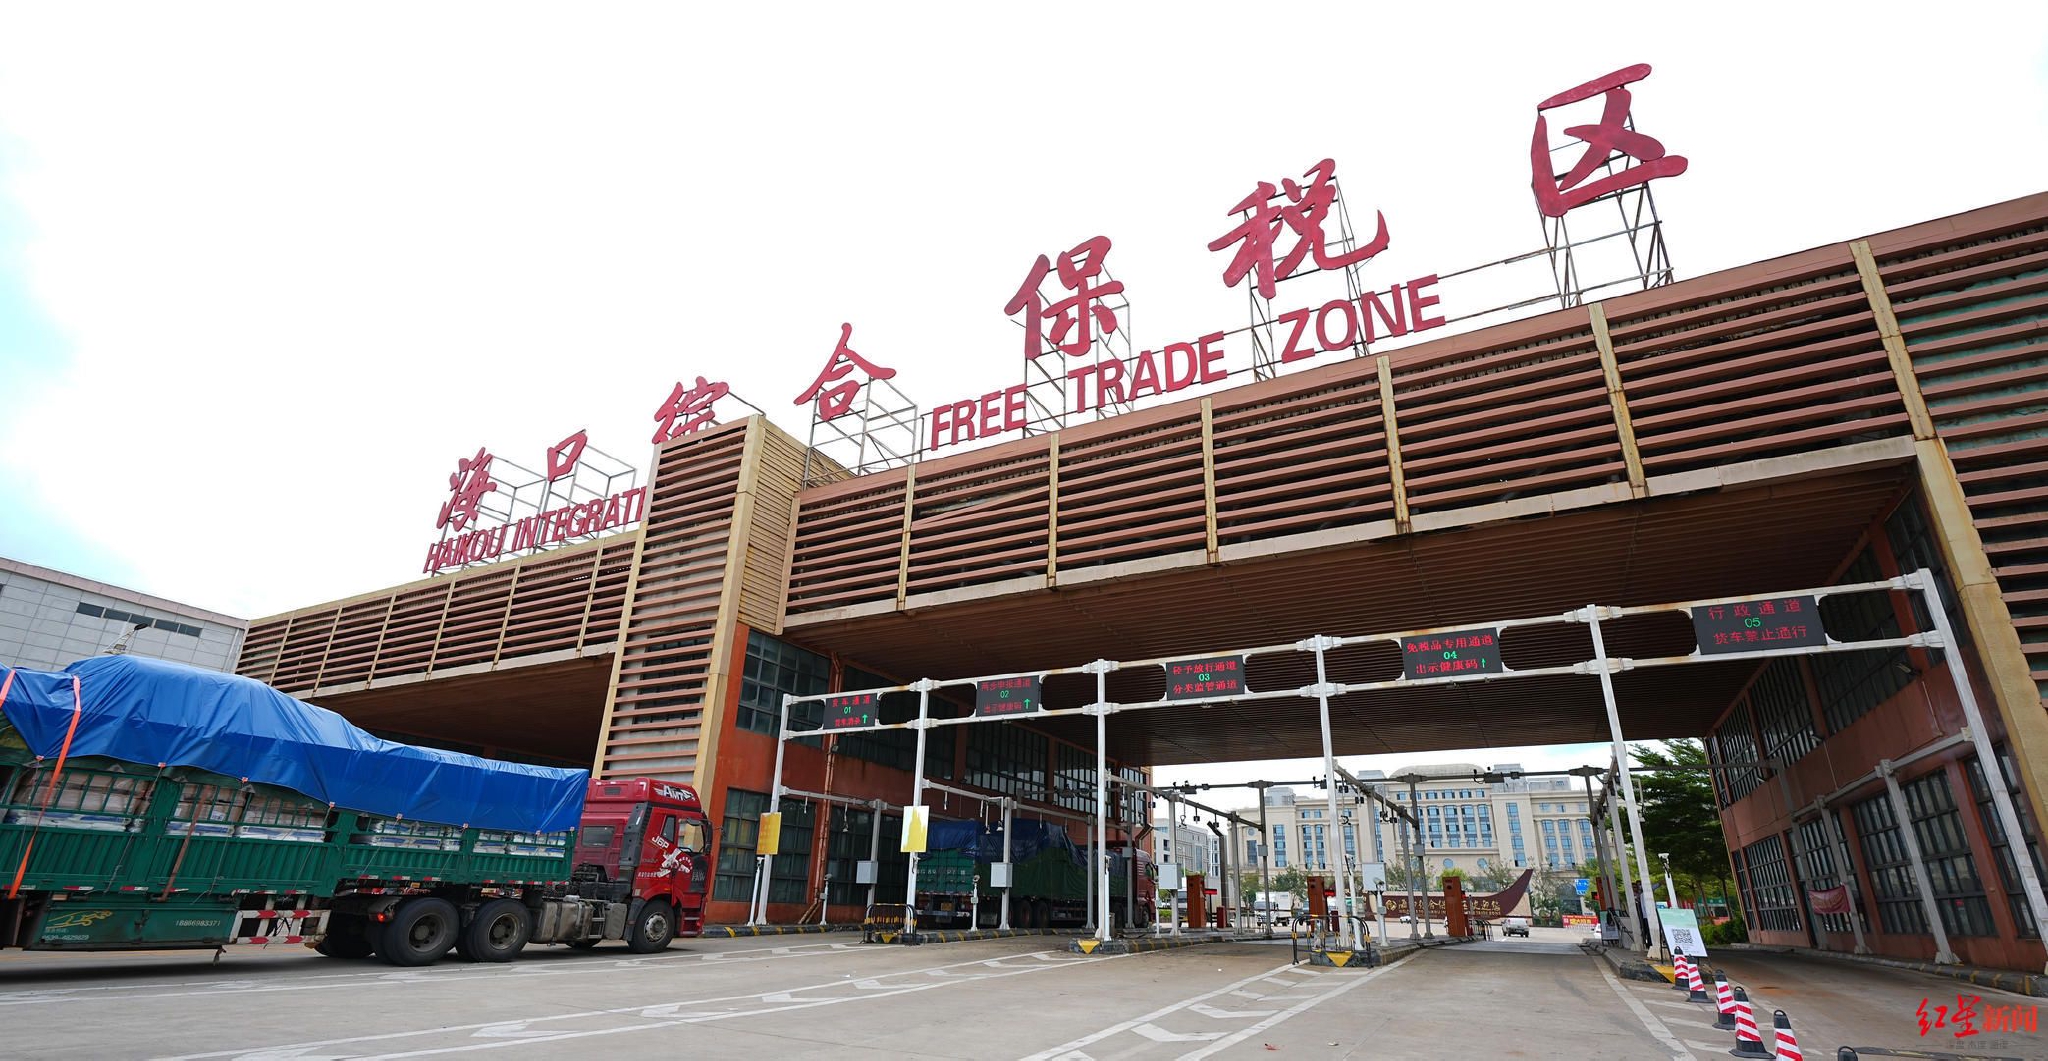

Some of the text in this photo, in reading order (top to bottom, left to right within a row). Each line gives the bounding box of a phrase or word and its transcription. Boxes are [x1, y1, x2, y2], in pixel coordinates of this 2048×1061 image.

[423, 523, 508, 573] HAIKOU
[931, 384, 1027, 451] FREE
[1067, 330, 1227, 414] TRADE
[1278, 273, 1446, 363] ZONE
[1708, 599, 1802, 620] 行政通道
[1744, 617, 1760, 628] 05
[1714, 625, 1807, 645] 货车禁止通行
[1407, 634, 1494, 653] 免税品专用通道
[1443, 651, 1458, 660] 04
[1416, 659, 1478, 674] 出示健康码
[1198, 673, 1211, 682] 03
[1000, 690, 1010, 699] 02
[843, 706, 852, 715] 01
